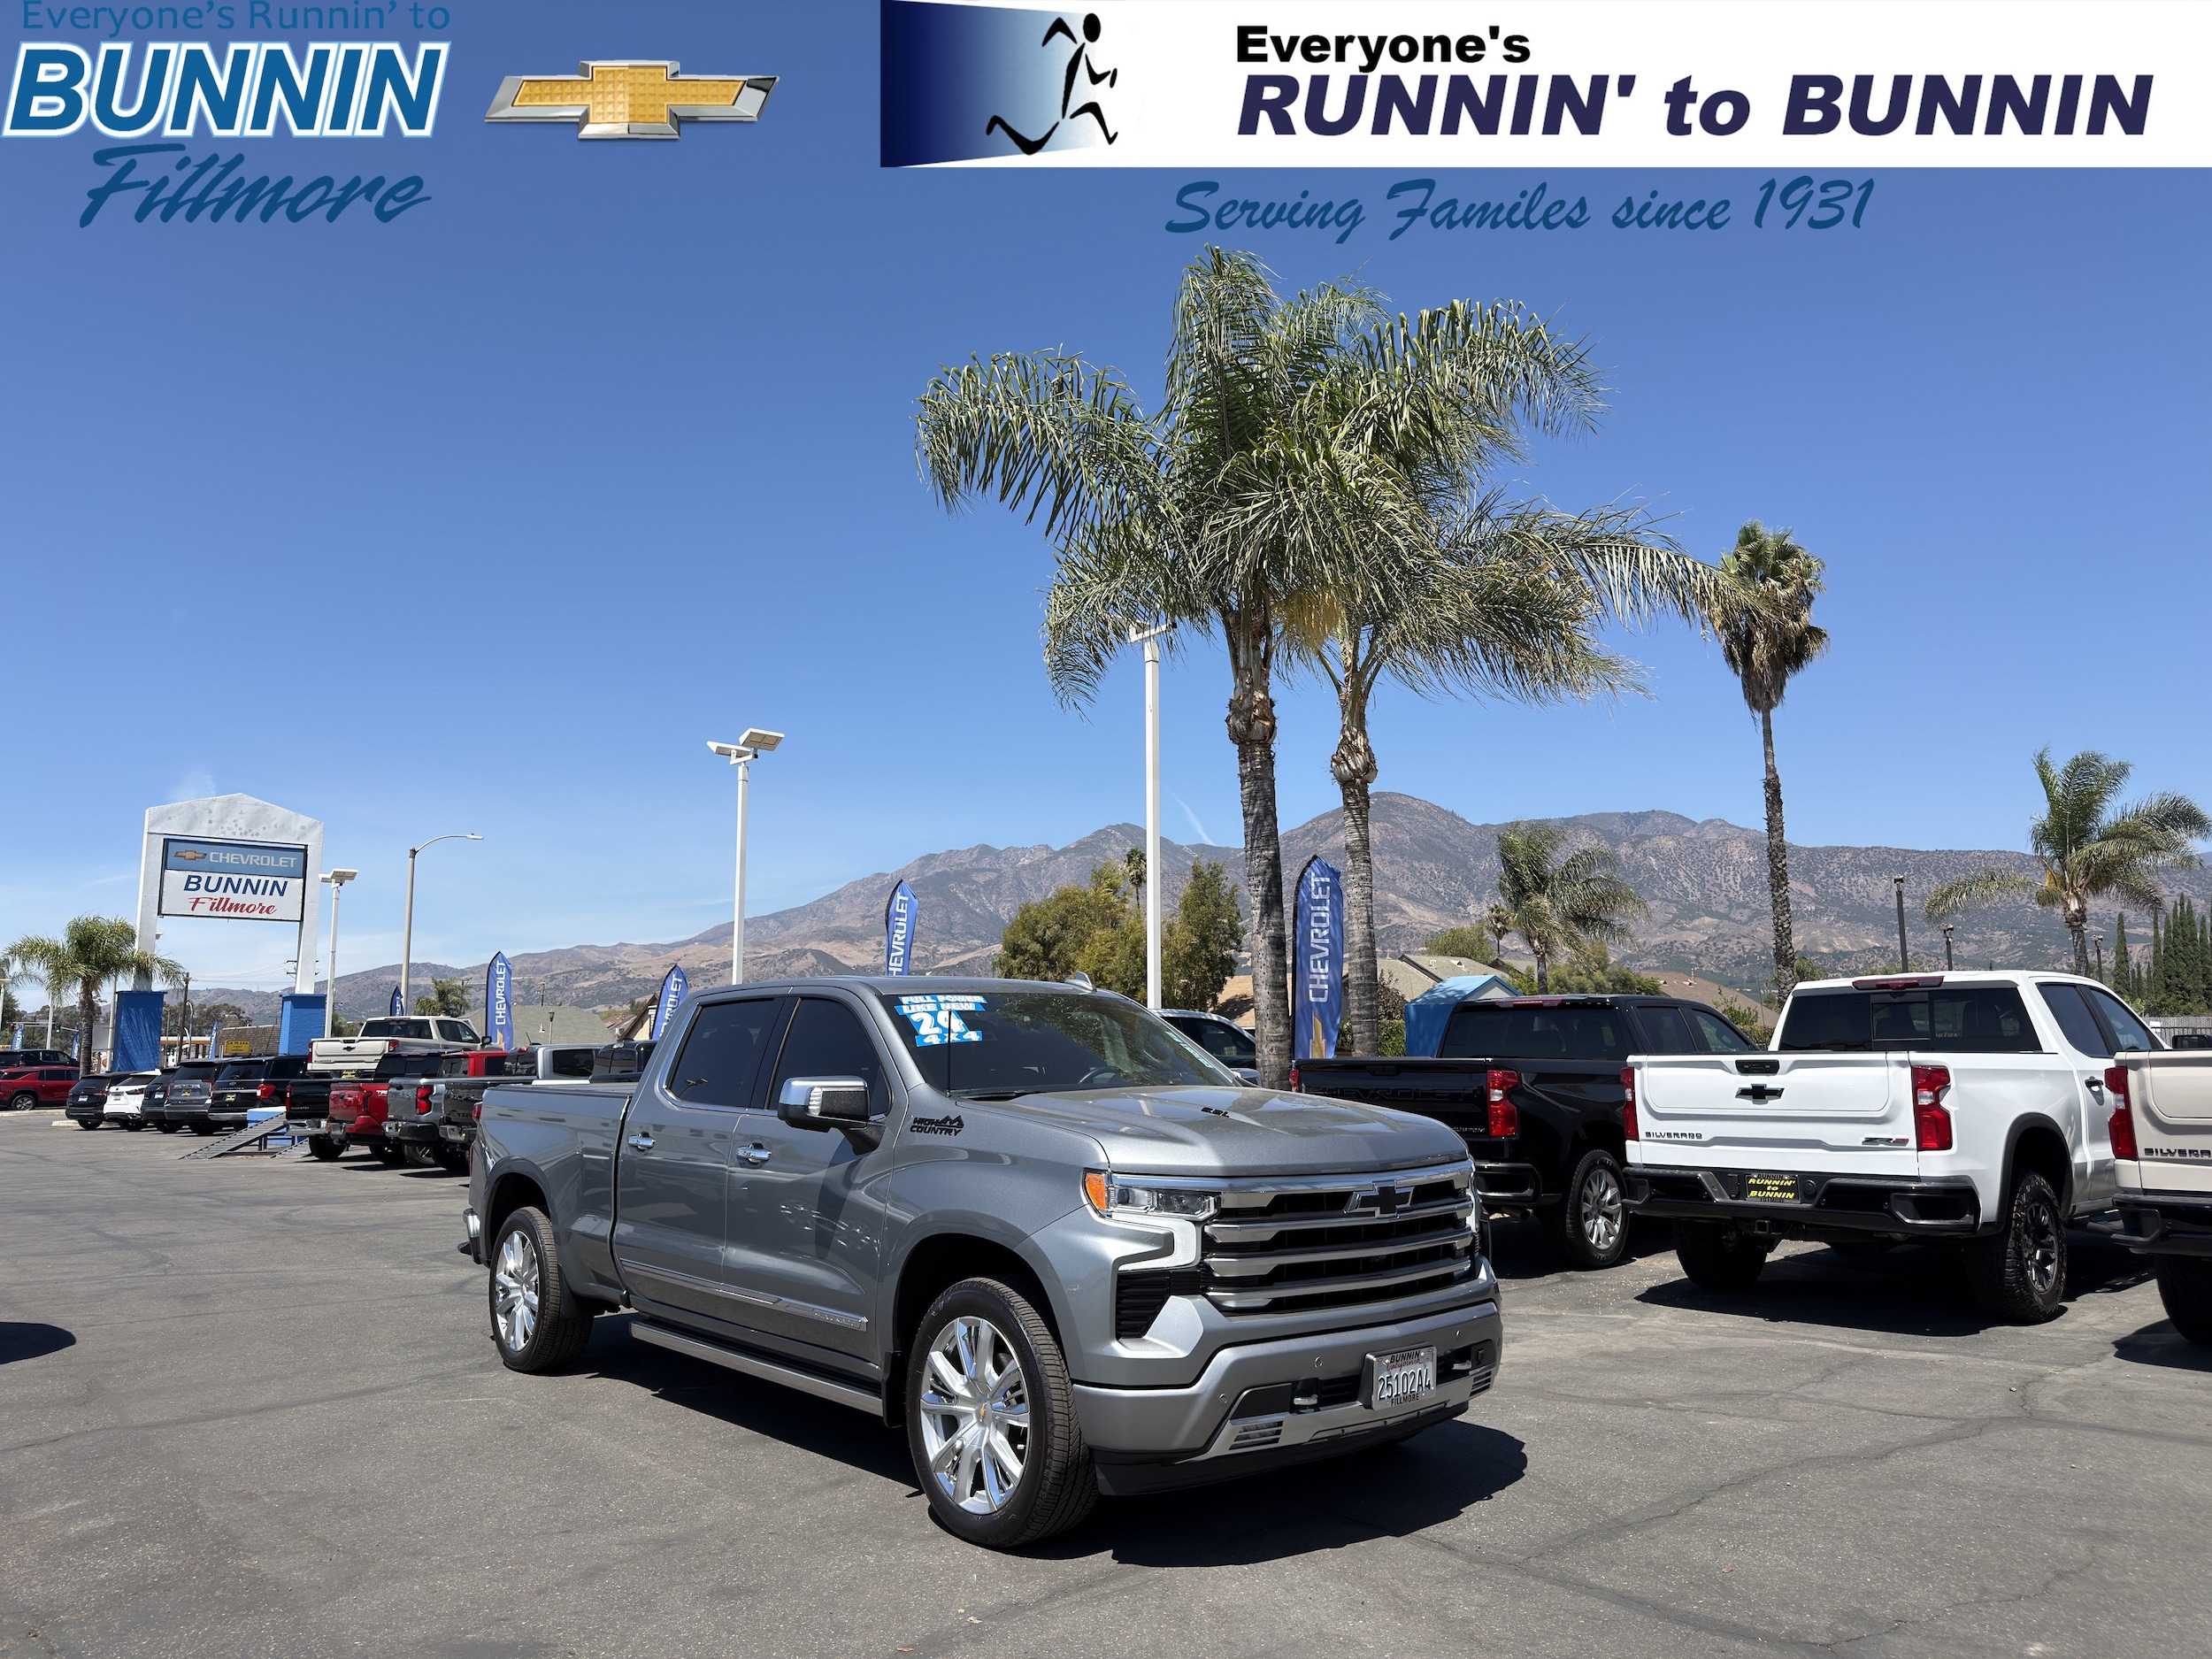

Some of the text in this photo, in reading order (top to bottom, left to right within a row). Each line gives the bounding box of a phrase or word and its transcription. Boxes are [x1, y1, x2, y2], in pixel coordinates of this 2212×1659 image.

[209, 851, 297, 868] CHEVROLET
[183, 874, 288, 897] BUNNIN
[188, 896, 278, 916] Fillmore
[888, 892, 909, 977] HEVROLET
[1309, 872, 1331, 1003] CHEVROLET
[495, 960, 507, 1025] CHEVROLET
[902, 995, 985, 1004] FULL POWER
[902, 1003, 938, 1013] LIKE
[910, 1010, 965, 1035] 24
[910, 1125, 963, 1136] COUNTRY
[1748, 1178, 1796, 1187] RUNNIN'
[1749, 1190, 1794, 1199] BUNNIN
[1390, 1350, 1421, 1363] BUNNIN
[1386, 1358, 1422, 1371] California
[1378, 1367, 1431, 1402] 25102A4
[1391, 1393, 1420, 1407] FILLMORE
